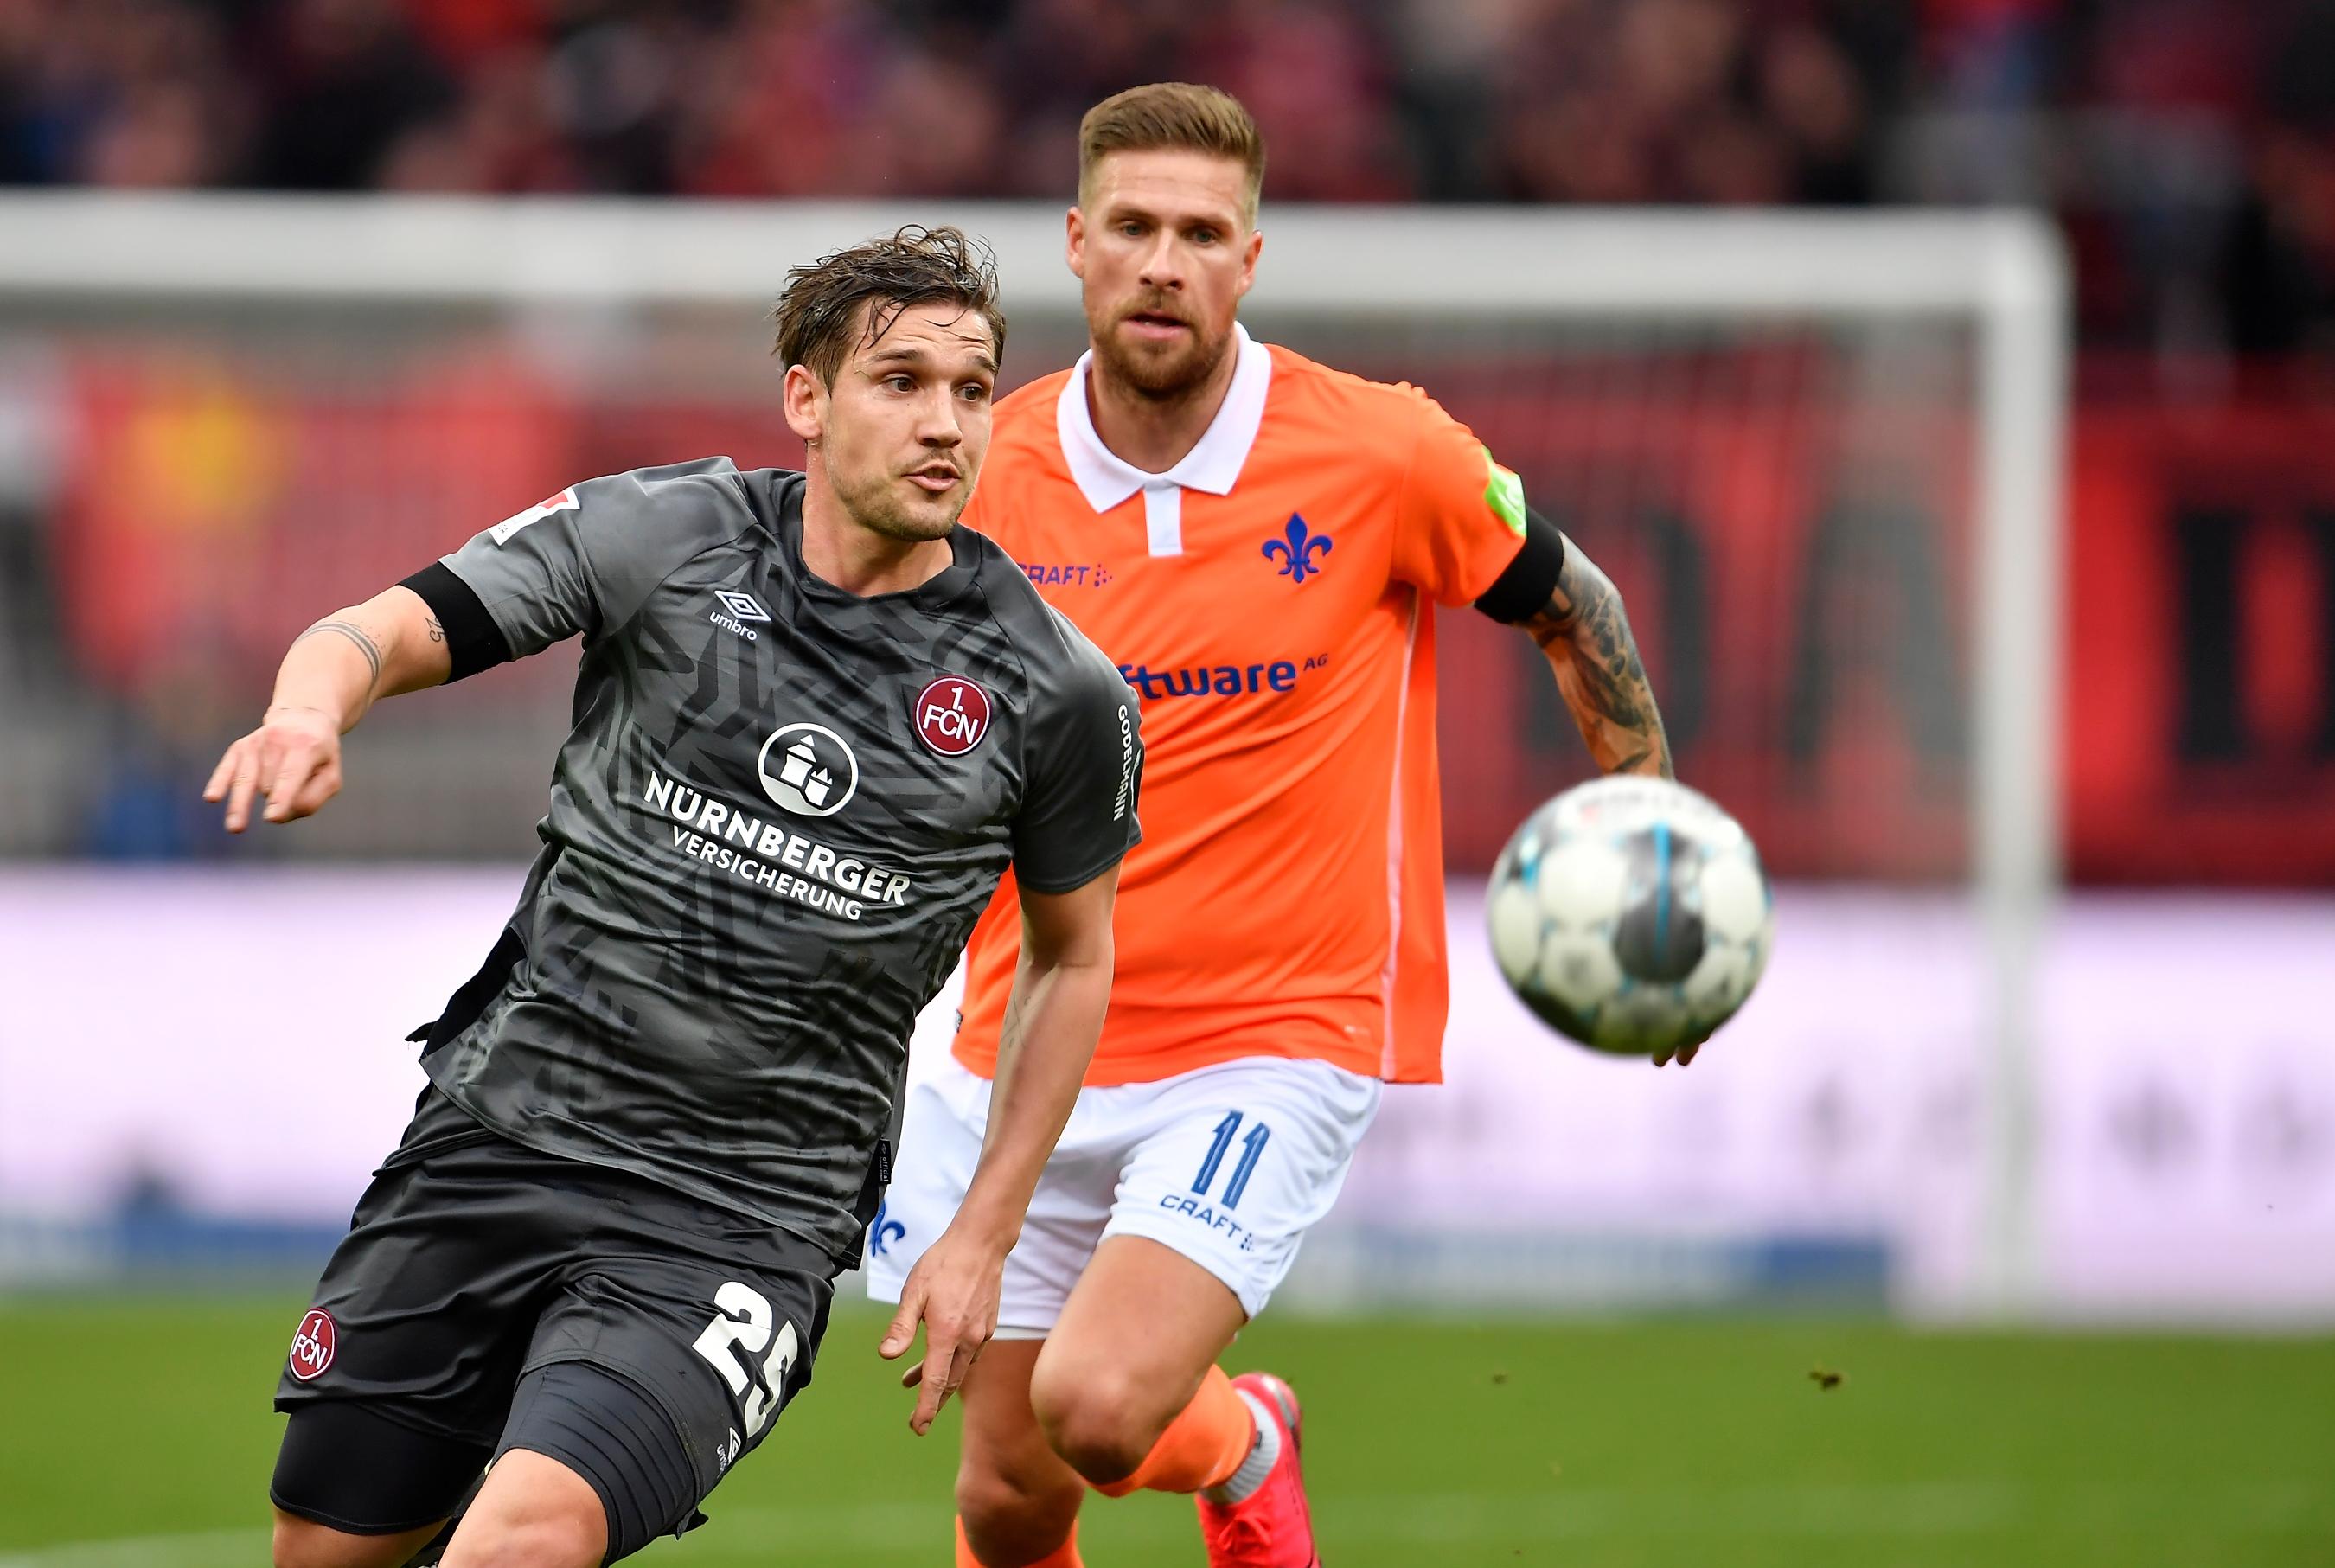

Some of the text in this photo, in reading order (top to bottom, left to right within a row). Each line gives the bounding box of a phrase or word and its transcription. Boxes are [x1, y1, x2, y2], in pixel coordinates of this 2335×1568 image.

[709, 611, 758, 641] umbro
[1303, 653, 1329, 672] AG
[951, 686, 964, 712] 1.
[922, 703, 979, 745] FCN
[643, 770, 910, 906] NÜRNBERGER
[673, 825, 864, 921] VERSICHERUNG
[1190, 1110, 1270, 1211] 11
[1160, 1194, 1243, 1238] CRAFT
[291, 1333, 328, 1370] FCN
[692, 1281, 799, 1439] 25
